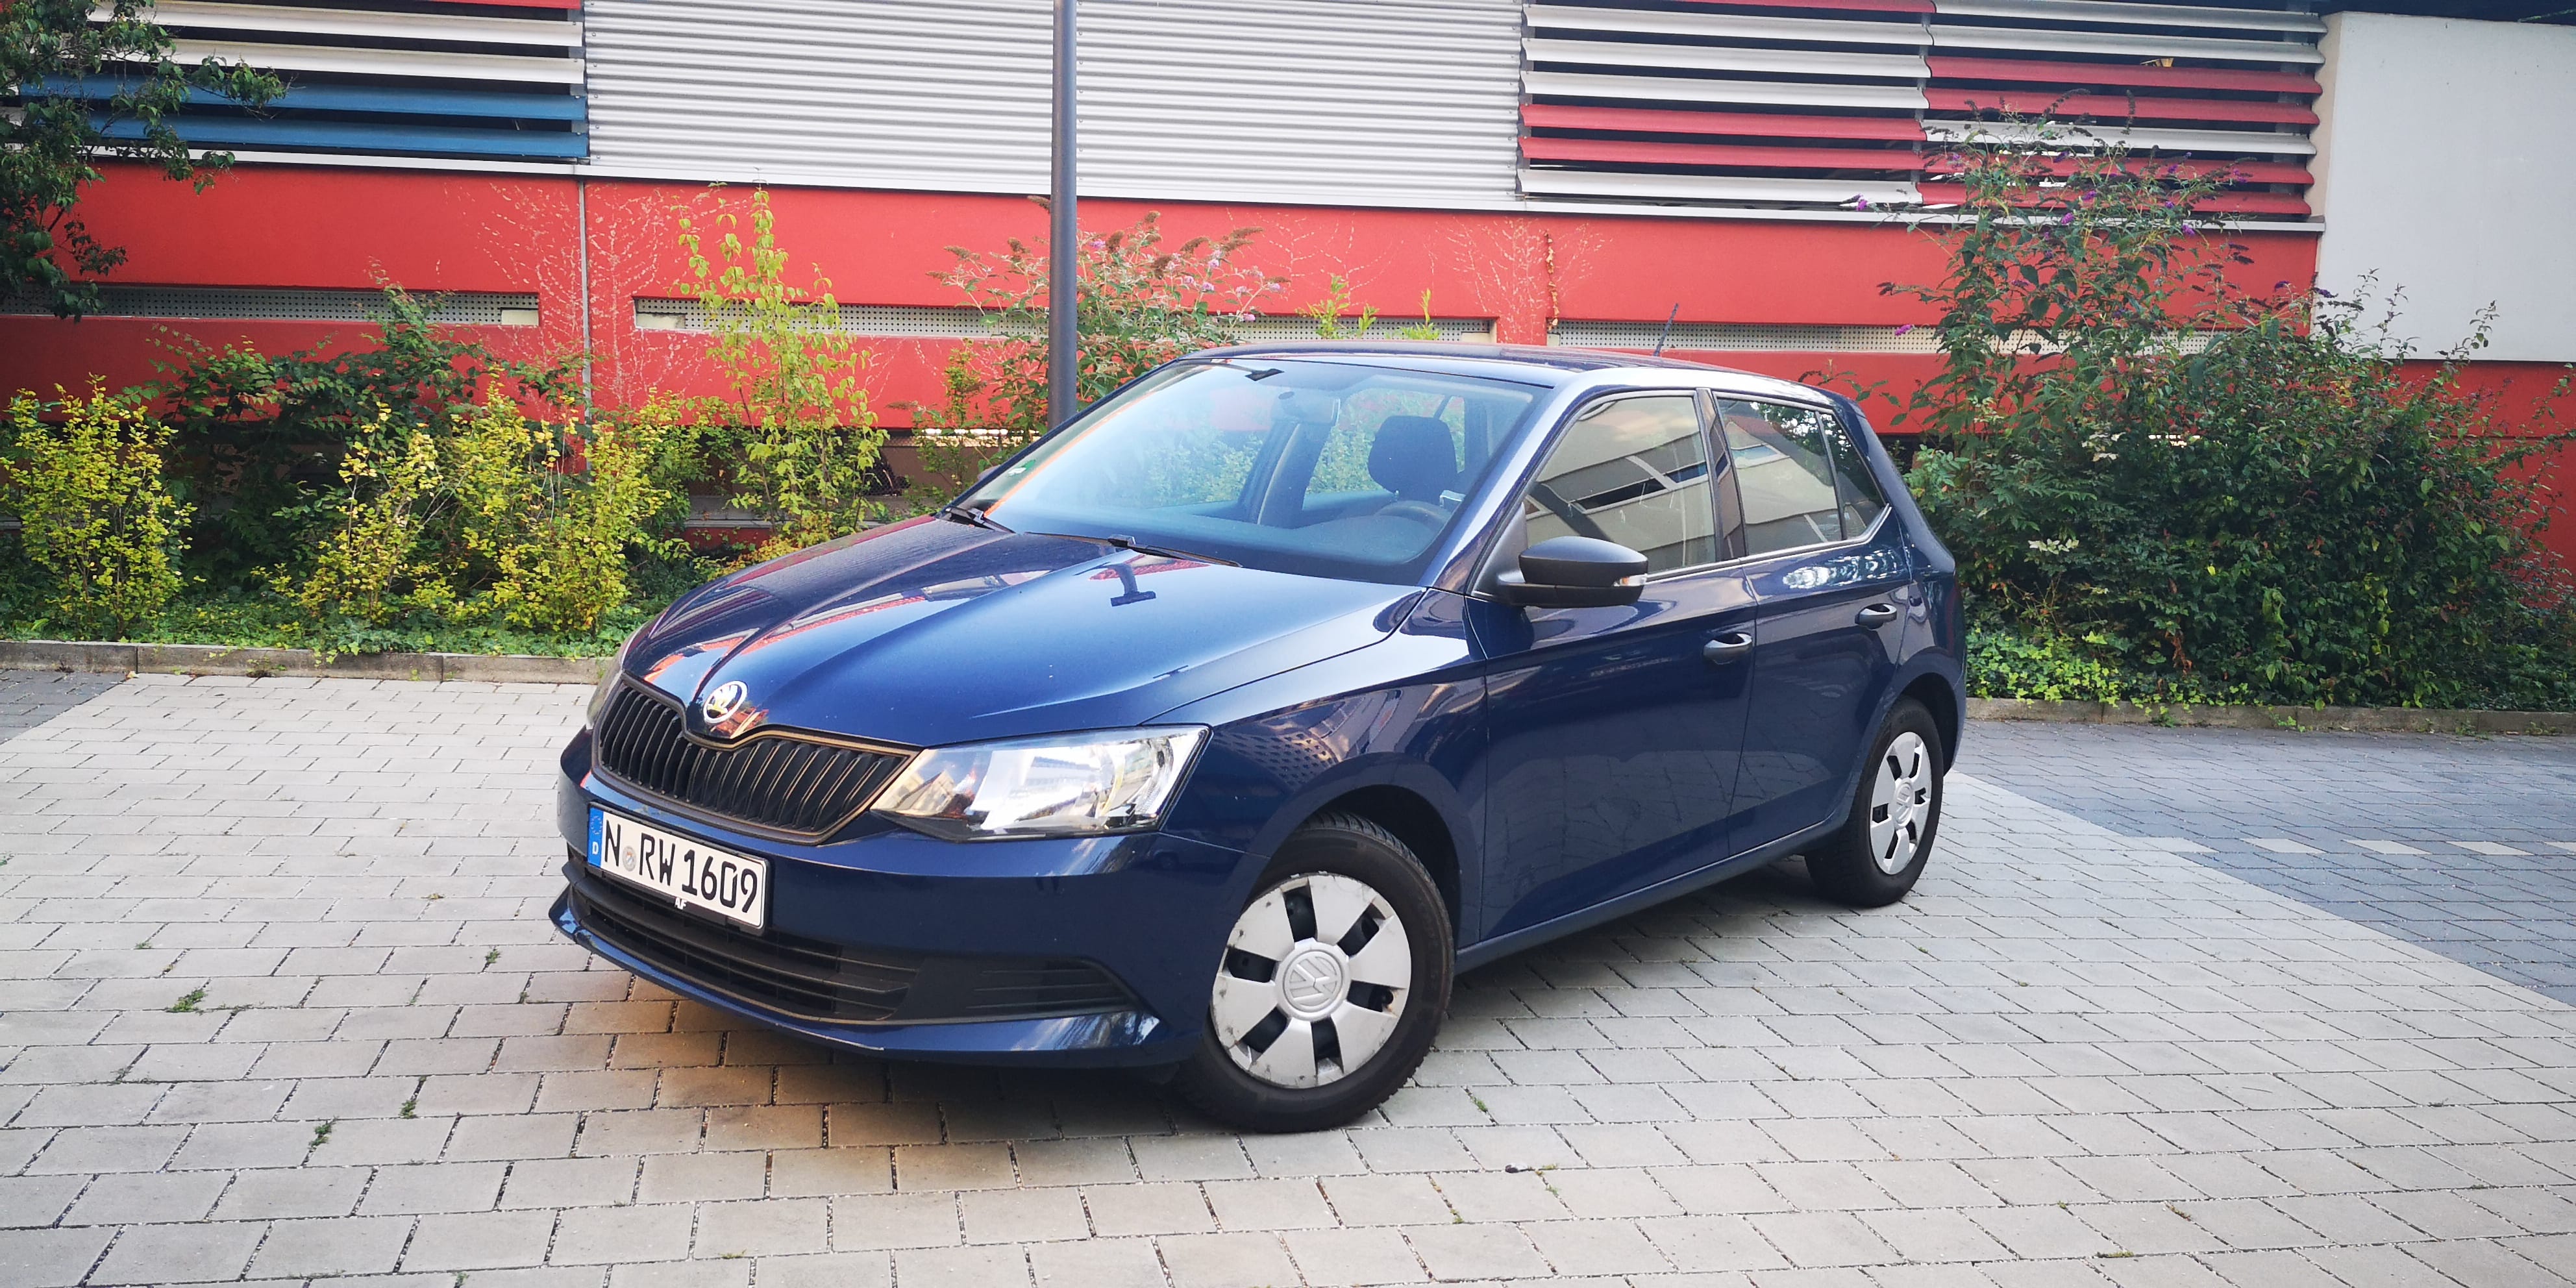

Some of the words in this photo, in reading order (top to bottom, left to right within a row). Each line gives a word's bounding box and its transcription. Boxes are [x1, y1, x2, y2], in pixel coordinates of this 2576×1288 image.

[592, 841, 599, 854] D
[604, 819, 621, 867] N
[639, 832, 675, 886] RW
[682, 849, 758, 913] 1609
